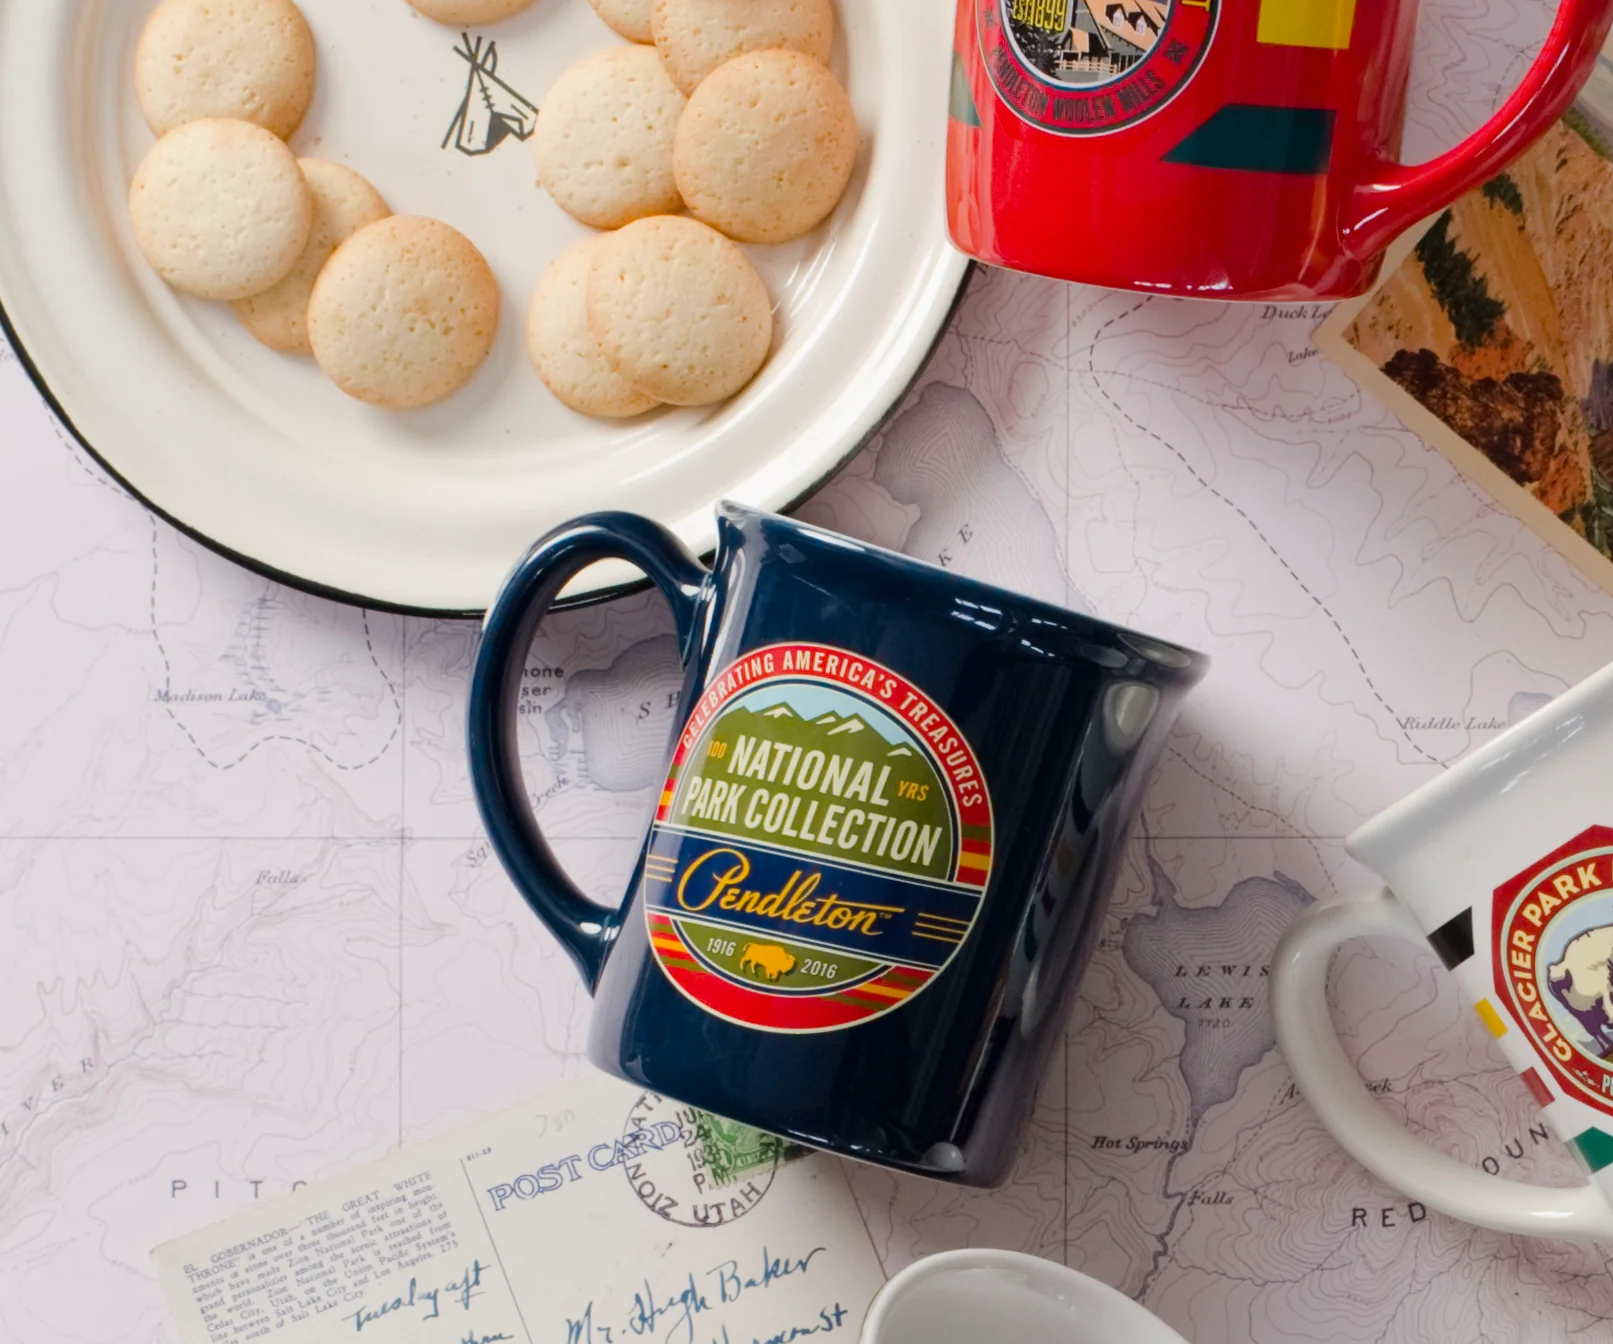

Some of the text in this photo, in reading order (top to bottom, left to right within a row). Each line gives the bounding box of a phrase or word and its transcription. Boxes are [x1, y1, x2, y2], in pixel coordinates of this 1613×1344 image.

[682, 651, 983, 807] CELEBRATING AMERICA'S TREASURES
[1404, 716, 1506, 729] Riddle Lake
[707, 734, 930, 807] 100 NATIONAL YRS
[681, 776, 943, 867] PARK COLLECTION
[1521, 862, 1602, 927] PARK
[705, 937, 838, 980] 1916 2016
[1175, 965, 1270, 977] LEWIS
[1177, 996, 1254, 1009] LAKE
[1511, 929, 1572, 1062] GLACIER
[1091, 1135, 1190, 1154] Hot Springs
[487, 1121, 684, 1212] POST CARD
[627, 1162, 679, 1220] ZION
[692, 1181, 761, 1224] UTAH
[1187, 1190, 1234, 1205] Falls
[1352, 1202, 1426, 1227] RED
